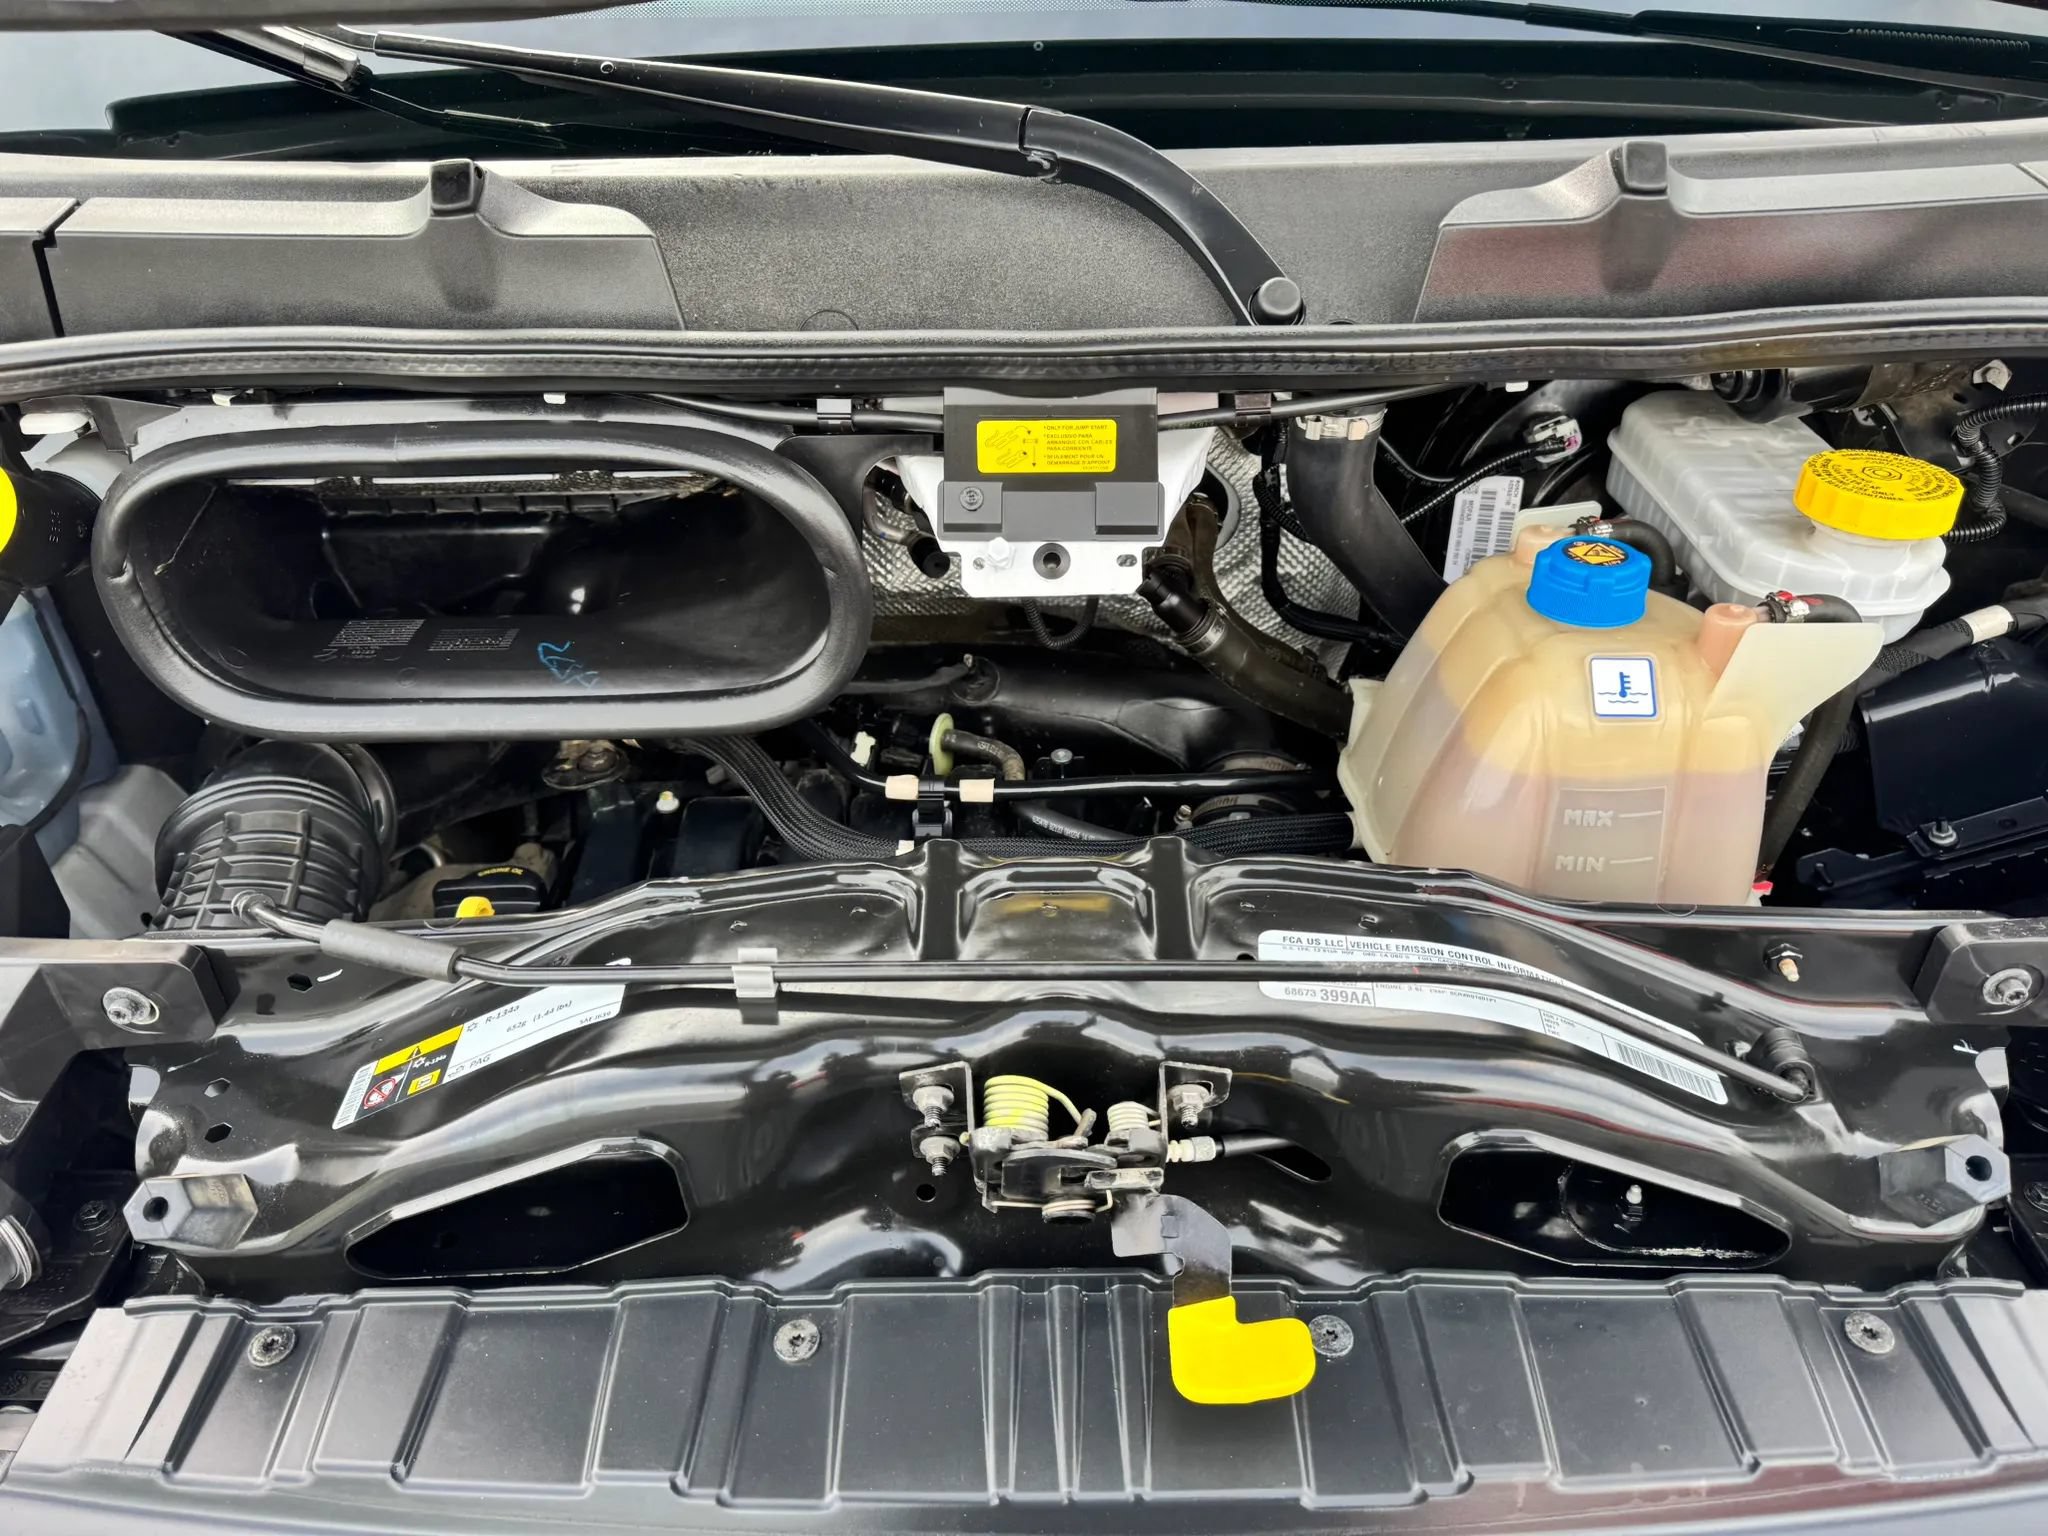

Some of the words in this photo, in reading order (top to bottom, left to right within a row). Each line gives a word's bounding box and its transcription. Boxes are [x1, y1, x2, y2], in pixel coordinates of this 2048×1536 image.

[1465, 500, 1474, 521] MOPAR
[1563, 809, 1614, 827] MAX
[1554, 855, 1606, 872] MIN
[1282, 936, 1304, 945] FCA
[1307, 938, 1321, 947] US
[1325, 939, 1344, 948] LLC
[1350, 941, 1392, 951] VEHICLE
[1396, 944, 1444, 957] EMISSION
[1448, 950, 1495, 966] CONTROL
[1284, 987, 1316, 997] 68673
[1320, 988, 1372, 1005] 399AA
[485, 1005, 520, 1025] R-134a
[506, 1020, 528, 1033] 652g
[469, 1055, 491, 1069] PAG
